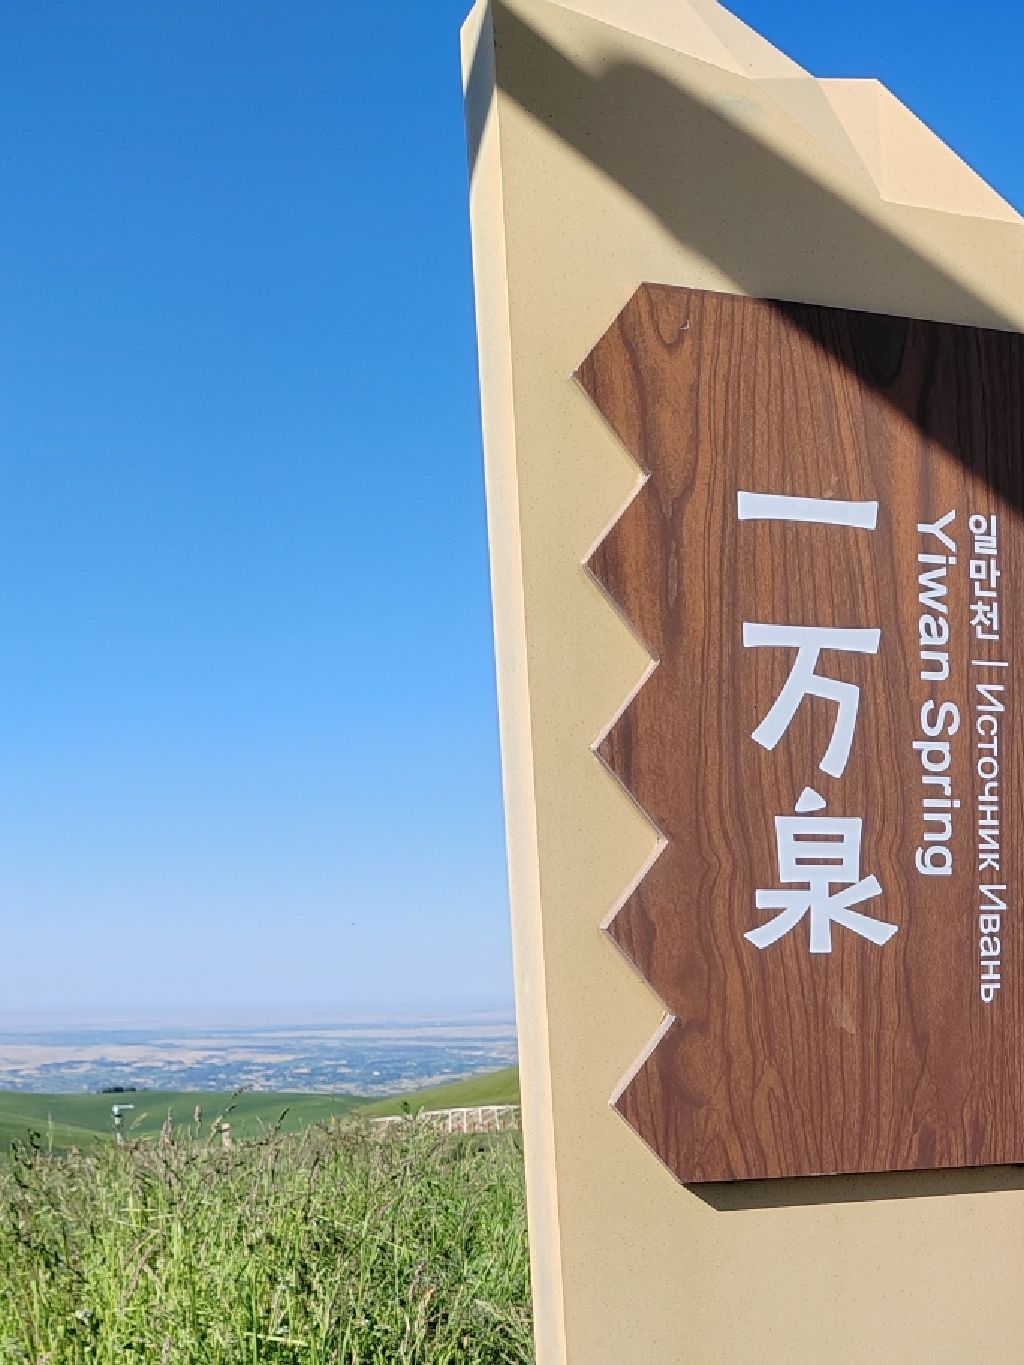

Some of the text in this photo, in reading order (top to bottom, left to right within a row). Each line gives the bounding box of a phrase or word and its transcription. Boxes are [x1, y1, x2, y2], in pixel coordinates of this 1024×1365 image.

[737, 491, 899, 953] 一万泉
[912, 509, 961, 876] Yiwan Spring
[968, 513, 1007, 1003] 일만천 Источник Ивань
